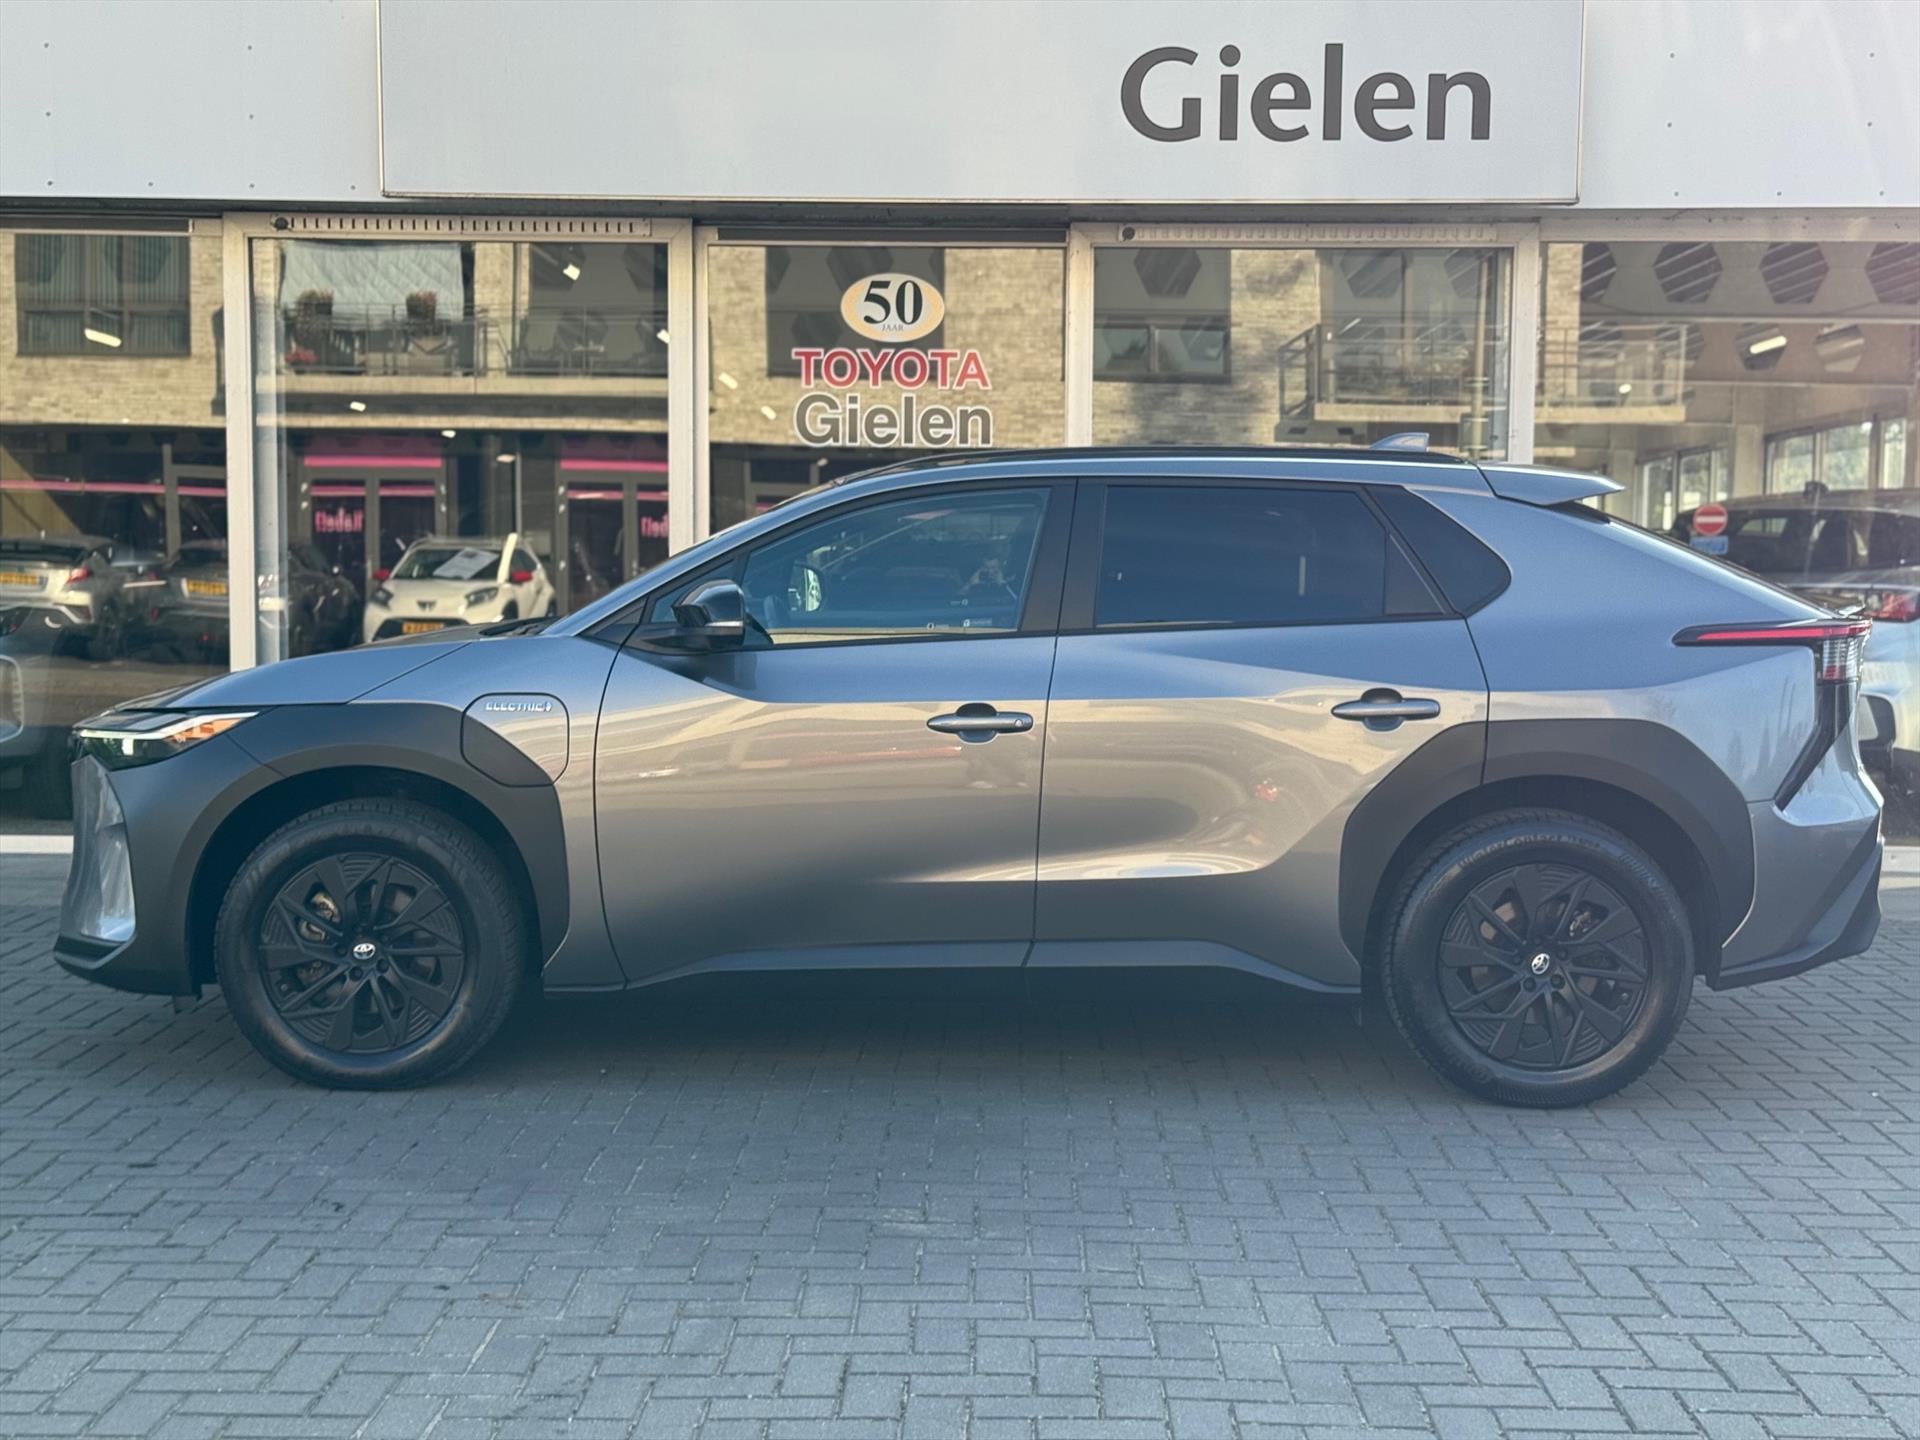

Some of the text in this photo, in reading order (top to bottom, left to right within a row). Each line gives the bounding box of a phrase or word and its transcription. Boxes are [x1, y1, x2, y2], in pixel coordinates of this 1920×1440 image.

[1120, 43, 1491, 142] Gielen
[863, 280, 923, 325] 50
[882, 323, 904, 332] JAAR
[793, 348, 992, 390] TOYOTA
[794, 392, 993, 447] Gielen
[485, 701, 545, 712] ELECTRIC
